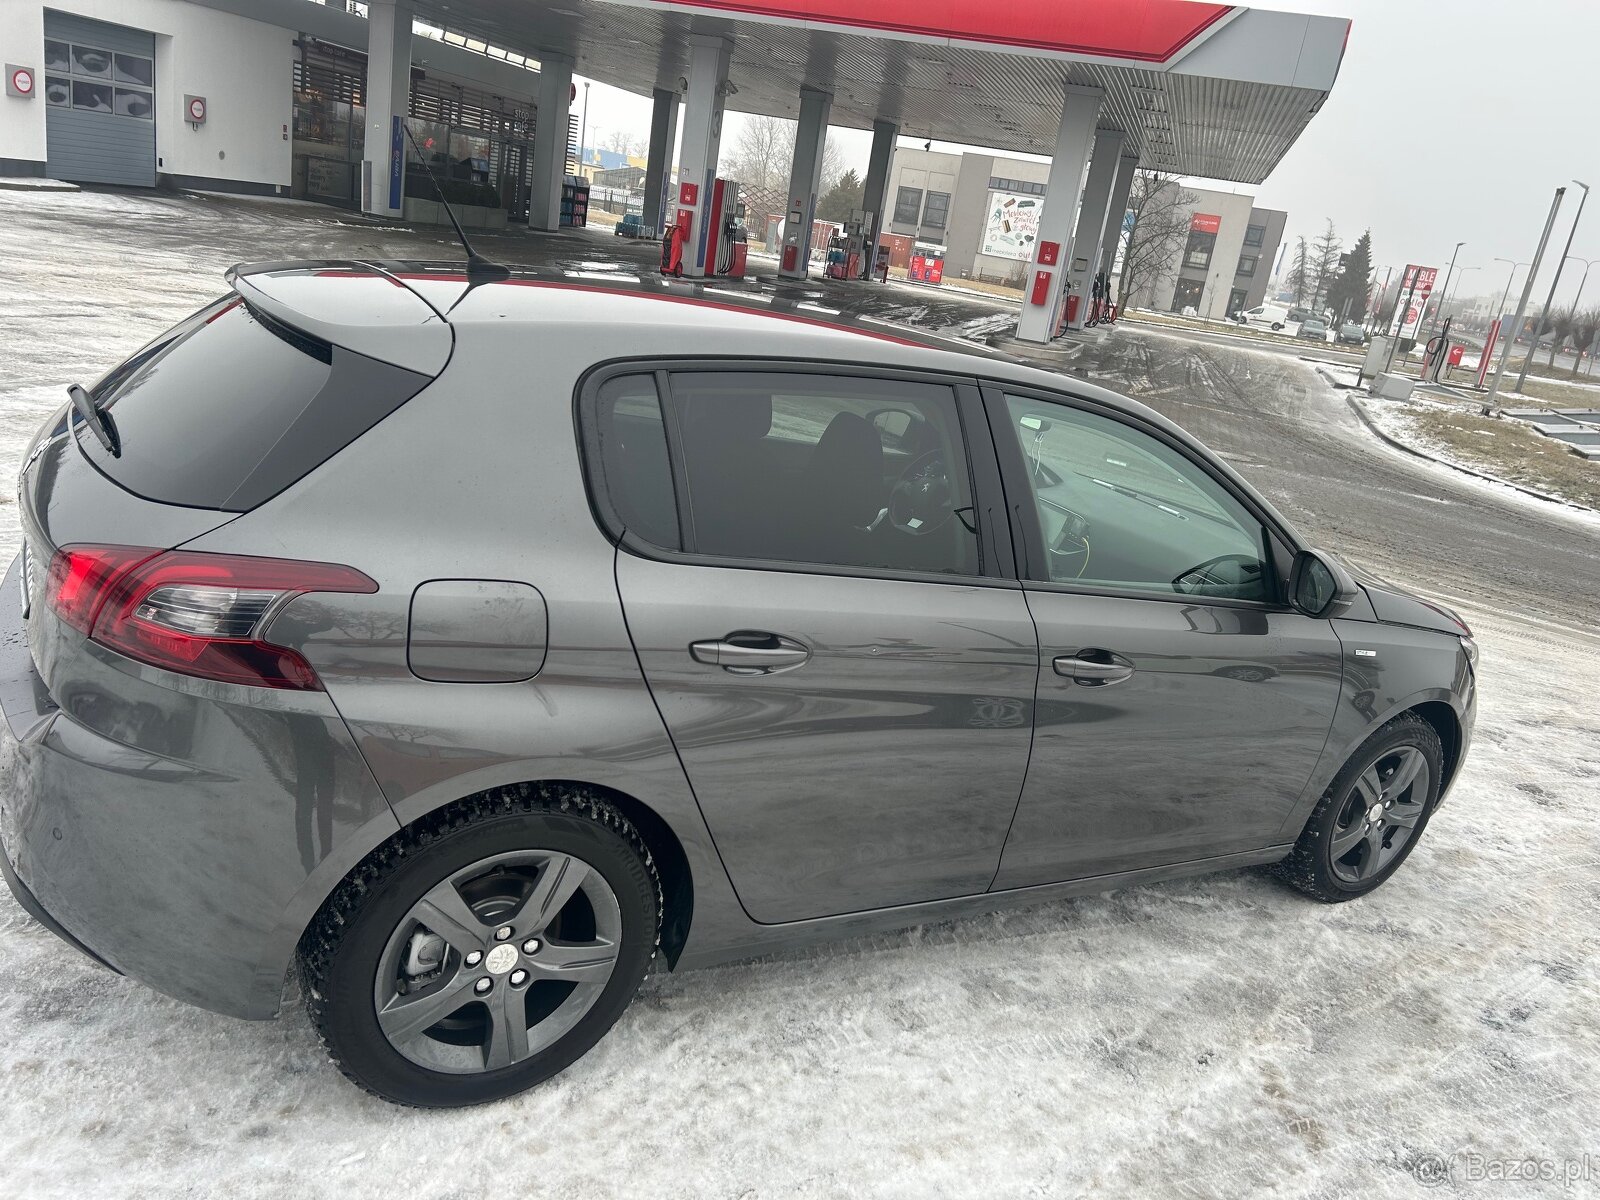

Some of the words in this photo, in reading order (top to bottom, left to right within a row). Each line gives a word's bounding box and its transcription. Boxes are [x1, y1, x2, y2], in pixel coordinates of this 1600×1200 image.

[514, 109, 530, 122] stop
[712, 110, 721, 138] 3
[1407, 268, 1435, 283] MBLE
